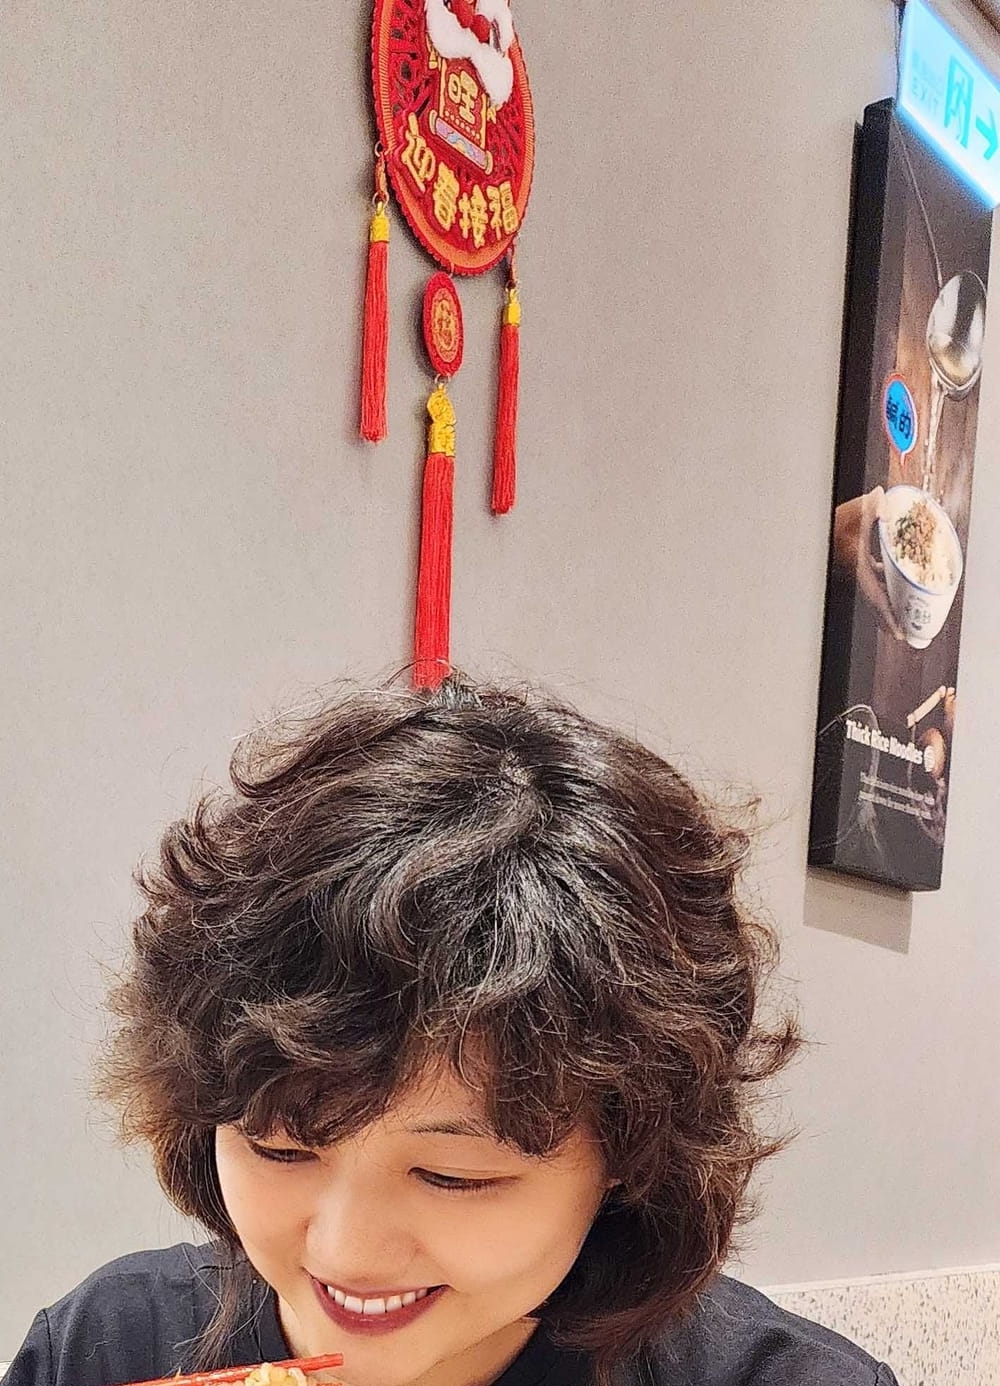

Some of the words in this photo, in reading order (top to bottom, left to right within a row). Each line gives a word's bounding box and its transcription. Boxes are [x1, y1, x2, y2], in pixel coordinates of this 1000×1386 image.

[448, 70, 479, 124] 旺
[845, 719, 871, 746] Thick
[871, 729, 889, 753] Rice
[889, 736, 923, 765] Noodles
